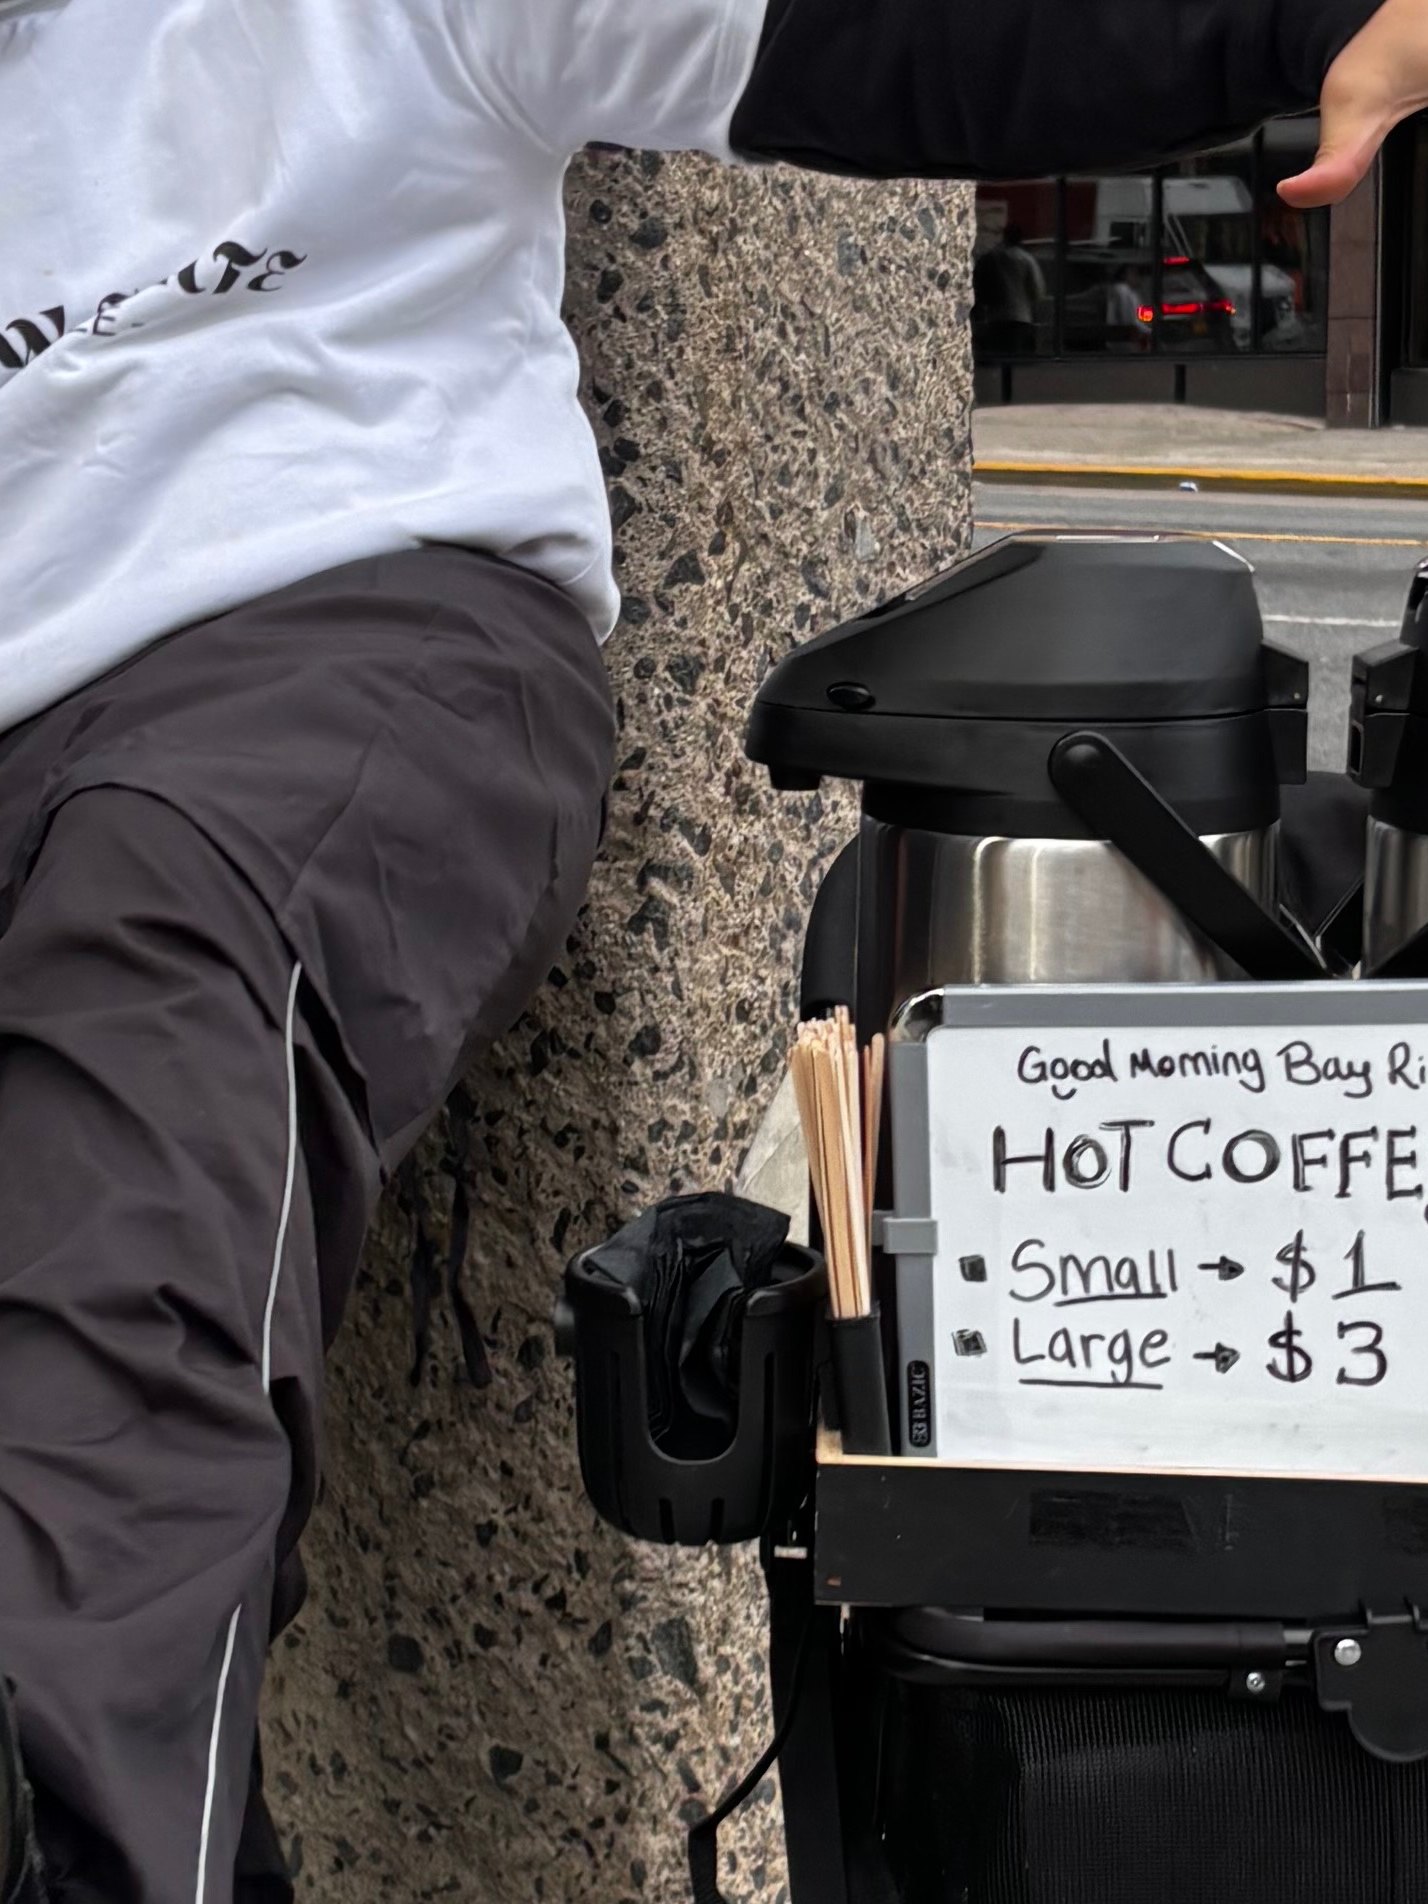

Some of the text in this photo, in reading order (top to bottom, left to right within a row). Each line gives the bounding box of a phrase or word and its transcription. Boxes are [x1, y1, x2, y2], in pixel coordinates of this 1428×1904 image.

[1017, 1038, 1118, 1086] Good
[1130, 1045, 1266, 1094] Morning
[1276, 1040, 1373, 1099] Bay
[992, 1118, 1155, 1194] HOT
[1009, 1238, 1179, 1303] Small
[1013, 1316, 1172, 1386] Large
